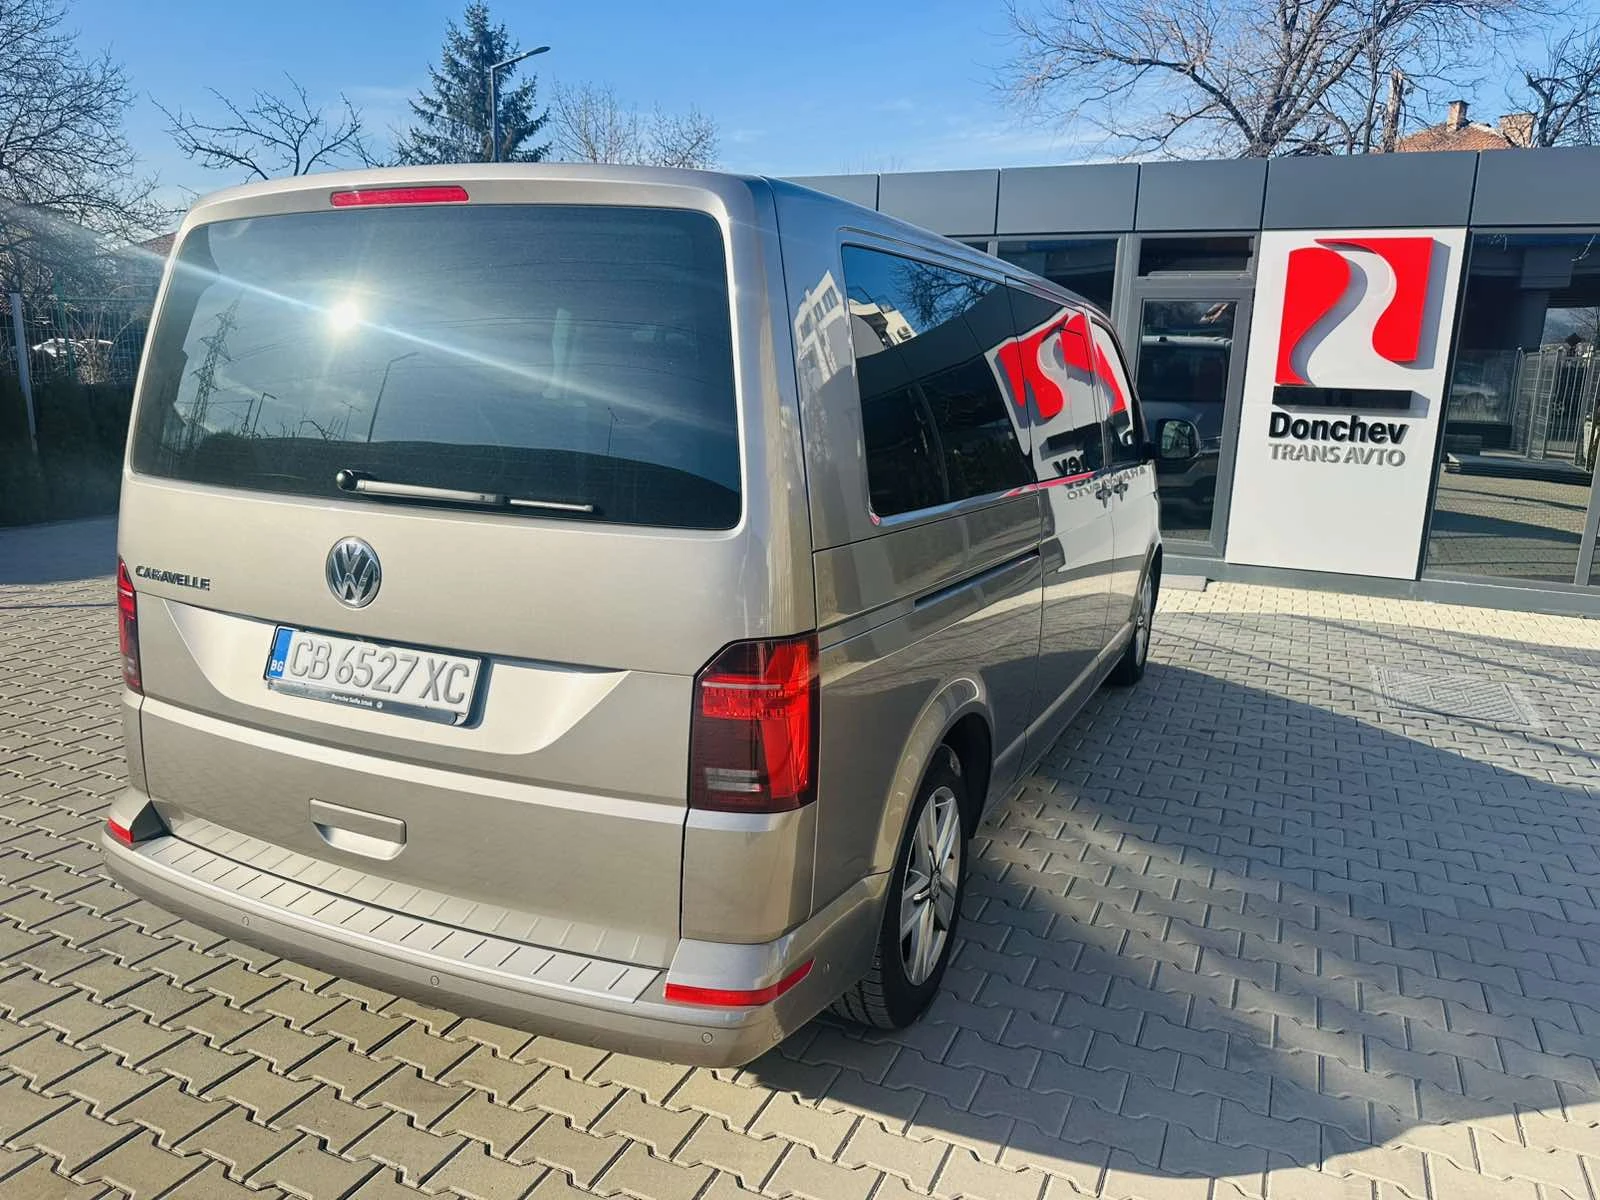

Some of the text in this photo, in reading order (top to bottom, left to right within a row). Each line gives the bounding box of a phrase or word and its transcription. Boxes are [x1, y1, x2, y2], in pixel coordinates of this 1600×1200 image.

[1269, 411, 1409, 445] Donchev
[135, 565, 211, 592] CARAVELLE
[270, 659, 285, 673] BG
[334, 645, 419, 695] 6527
